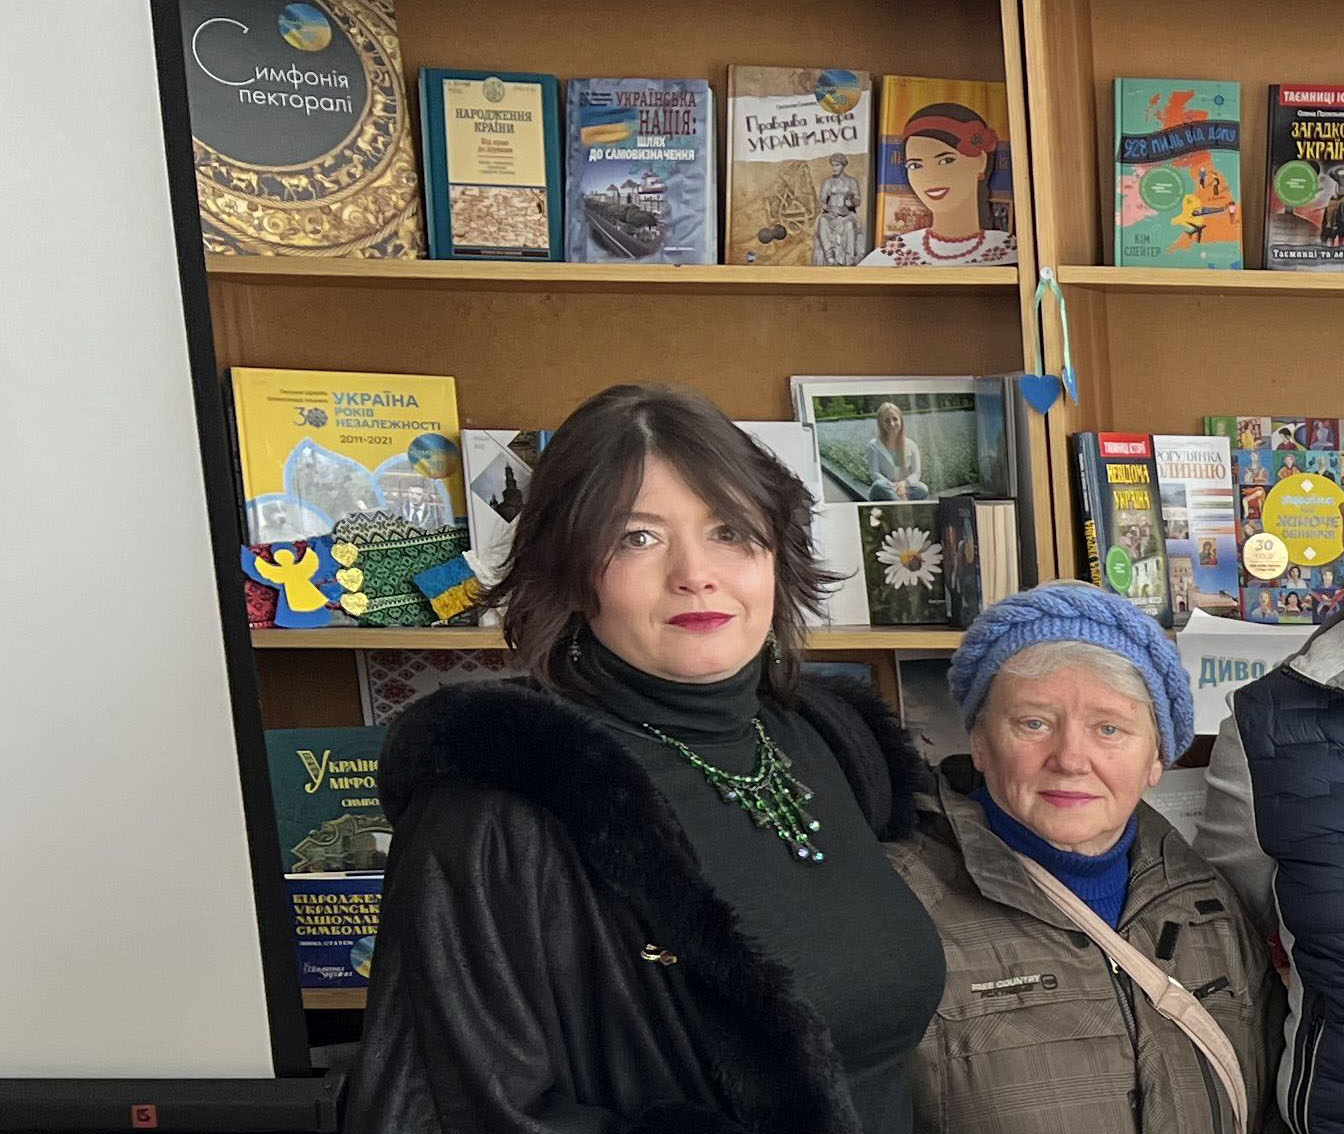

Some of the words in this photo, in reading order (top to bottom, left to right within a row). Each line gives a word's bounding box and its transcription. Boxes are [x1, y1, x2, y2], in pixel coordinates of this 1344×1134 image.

[193, 18, 349, 89] Симфонія
[240, 88, 353, 115] пекторалі
[616, 89, 696, 107] УКРАЇНСЬКА
[1284, 91, 1335, 104] ТАЄМНИЦІ
[456, 108, 532, 121] НАРОДЖЕННЯ
[475, 122, 514, 133] КРАЇНИ
[639, 109, 697, 139] НАЦІЯ:
[746, 113, 807, 134] Правдива
[637, 136, 665, 147] ШЛЯХ
[1125, 139, 1147, 158] 928
[1185, 128, 1205, 143] ВІД
[1209, 127, 1236, 141] ДОМУ
[589, 149, 602, 161] ДО
[606, 150, 694, 160] САМОВИЗНАЧЕННЯ
[1135, 234, 1150, 244] КІМ
[1321, 250, 1331, 258] та
[332, 391, 419, 408] УКРАЇНА
[335, 408, 375, 417] РОКІВ
[336, 419, 441, 431] НЕЗАЛЕЖНОСТІ
[340, 435, 392, 445] 2011-2021
[1157, 451, 1222, 463] ОГУЛЯНКА
[1106, 464, 1150, 484] НЕВІДОМА
[1159, 464, 1225, 479] ЛИННЮ
[1113, 490, 1150, 510] УКРАЇНА
[1255, 540, 1273, 550] 30
[1199, 655, 1266, 687] ДИВО
[297, 750, 378, 793] УКРАЇН
[330, 777, 377, 790] МІФО
[295, 905, 380, 915] УКРАЇНСЬК
[296, 916, 379, 925] НАЦІОНАЛЬ
[296, 926, 378, 935] СИМВОЛІК
